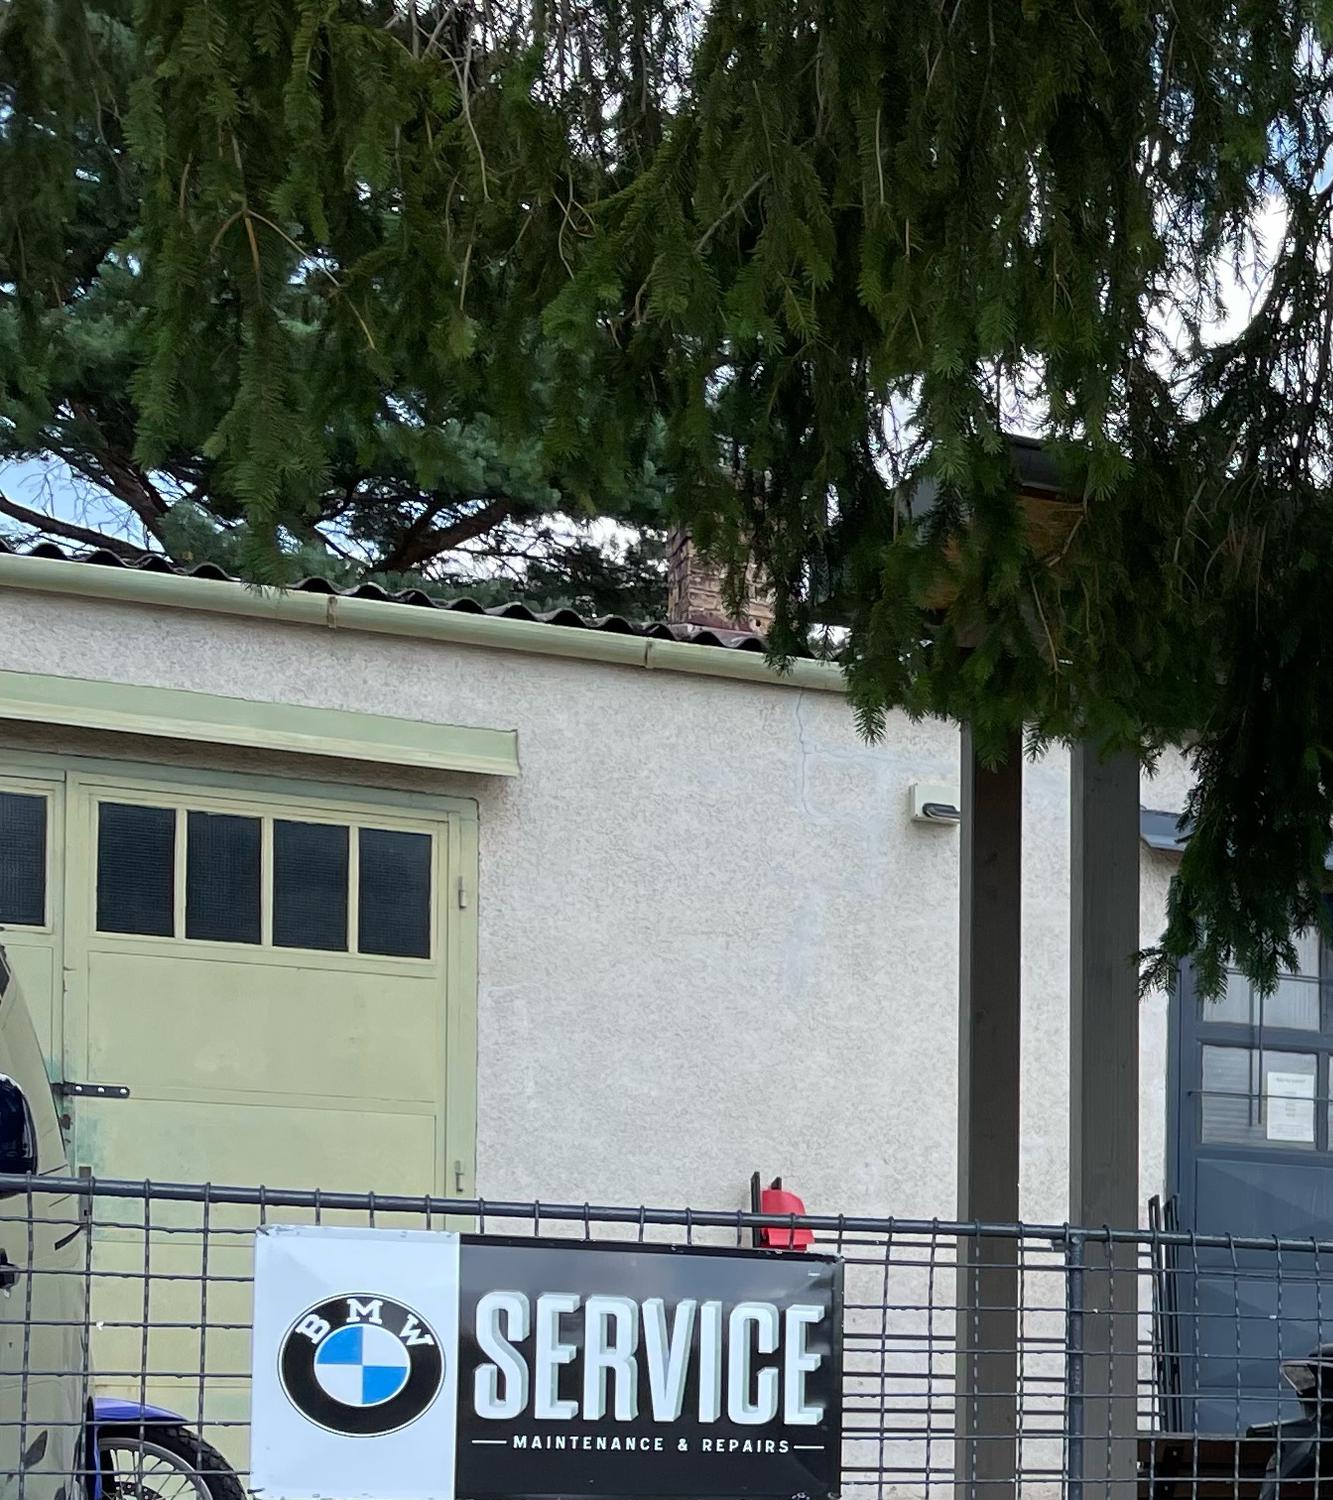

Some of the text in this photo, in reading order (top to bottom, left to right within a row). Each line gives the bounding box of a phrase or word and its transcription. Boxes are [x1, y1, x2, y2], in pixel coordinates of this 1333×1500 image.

[295, 1299, 435, 1350] BMW
[473, 1290, 826, 1426] SERVICE
[513, 1435, 790, 1453] MAINTENANCE & REPAIRS
